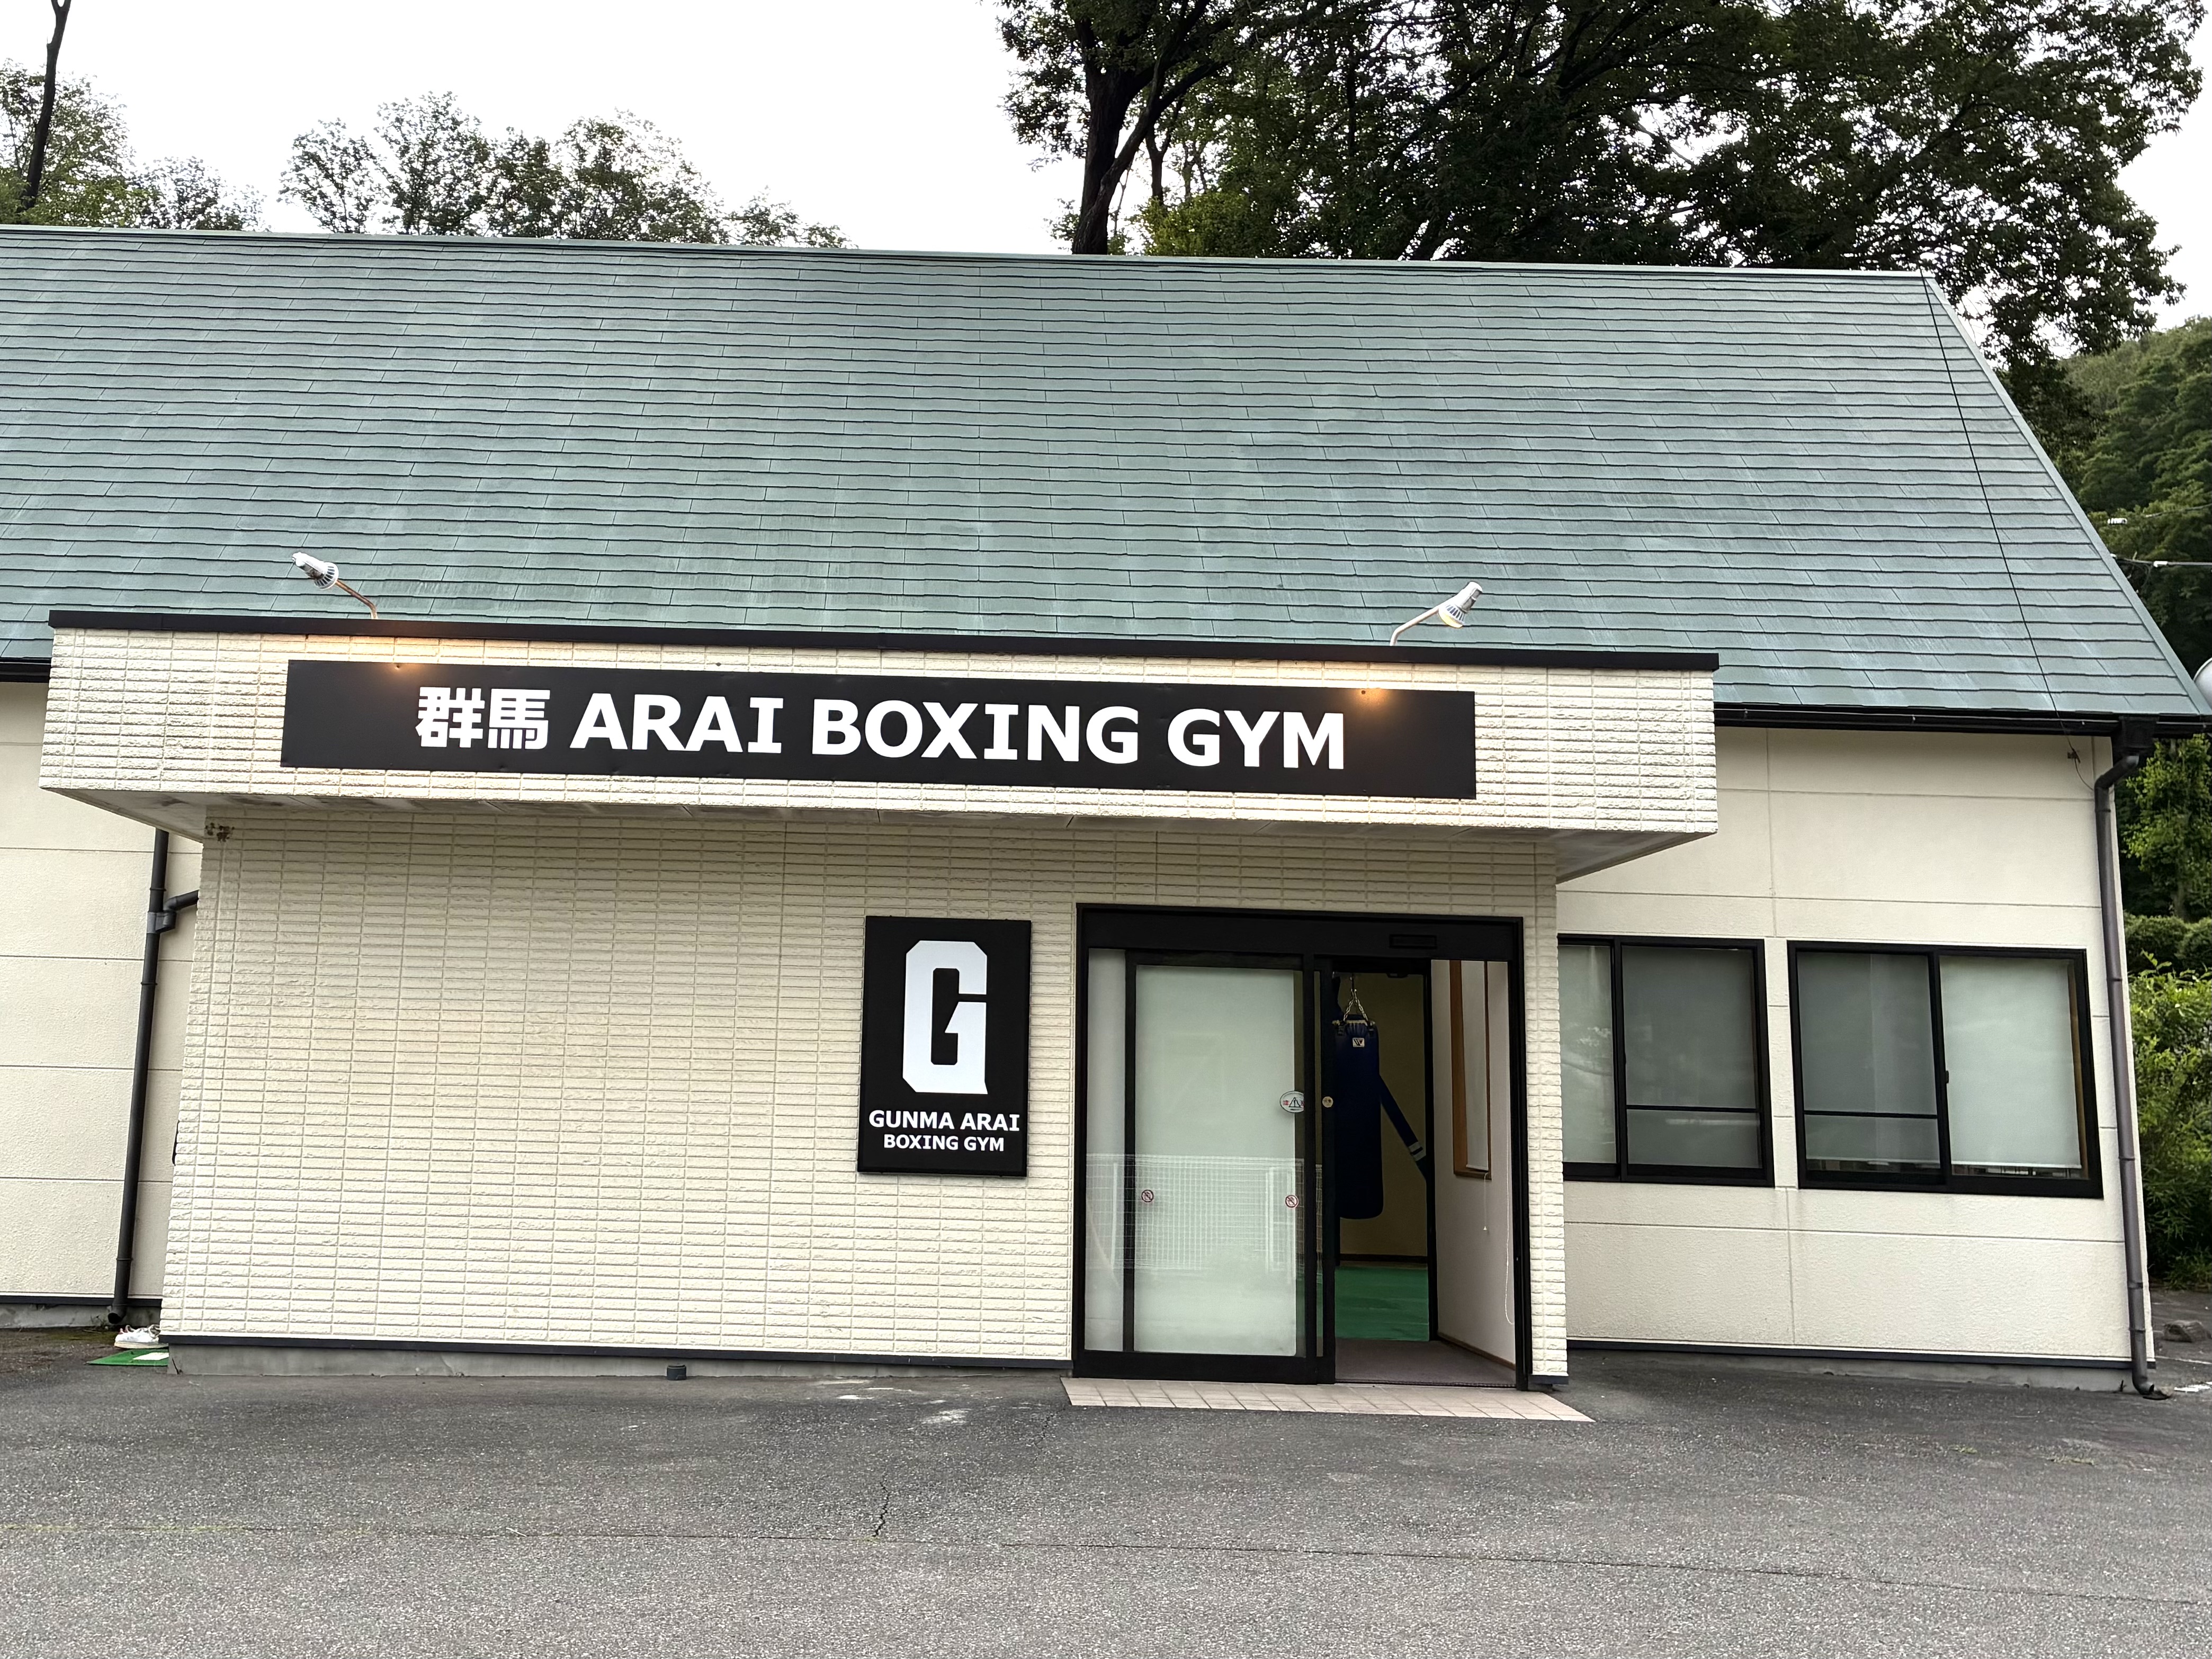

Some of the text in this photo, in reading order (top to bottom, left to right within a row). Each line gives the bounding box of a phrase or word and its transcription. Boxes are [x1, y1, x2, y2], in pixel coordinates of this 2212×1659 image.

[416, 687, 1344, 769] 群馬 ARAI BOXING GYM
[903, 940, 988, 1094] G
[869, 1110, 1020, 1132] GUNMA ARAI
[884, 1134, 1004, 1152] BOXING GYM
